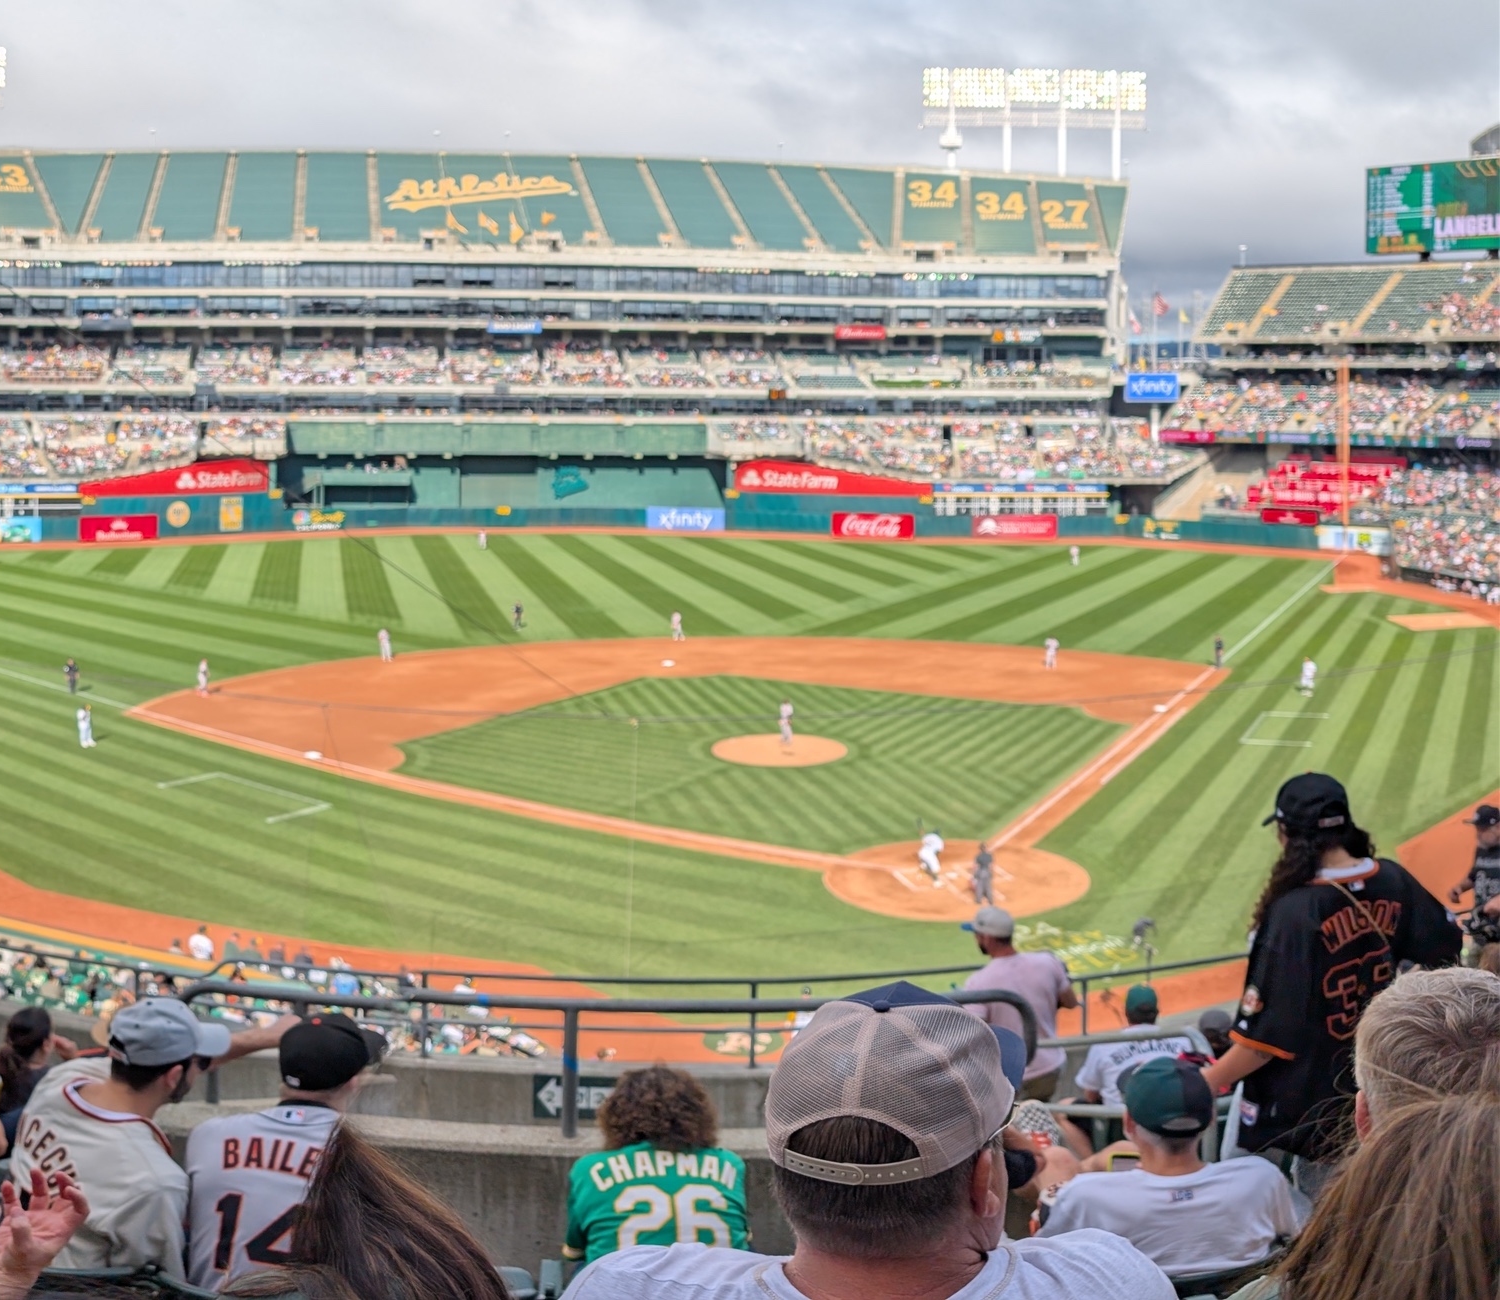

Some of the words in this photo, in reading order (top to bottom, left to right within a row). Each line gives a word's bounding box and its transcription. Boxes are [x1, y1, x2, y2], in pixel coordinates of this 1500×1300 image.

[384, 172, 574, 208] Athletics
[907, 180, 959, 202] 34
[975, 192, 1028, 215] 34
[1040, 200, 1091, 223] 27
[1130, 375, 1176, 397] xfinity
[658, 508, 713, 531] xfinity
[1320, 899, 1402, 954] WILSON
[223, 1137, 325, 1180] BAILE
[589, 1150, 737, 1193] CHAPMAN
[213, 1191, 312, 1272] 14
[614, 1184, 732, 1248] 26
